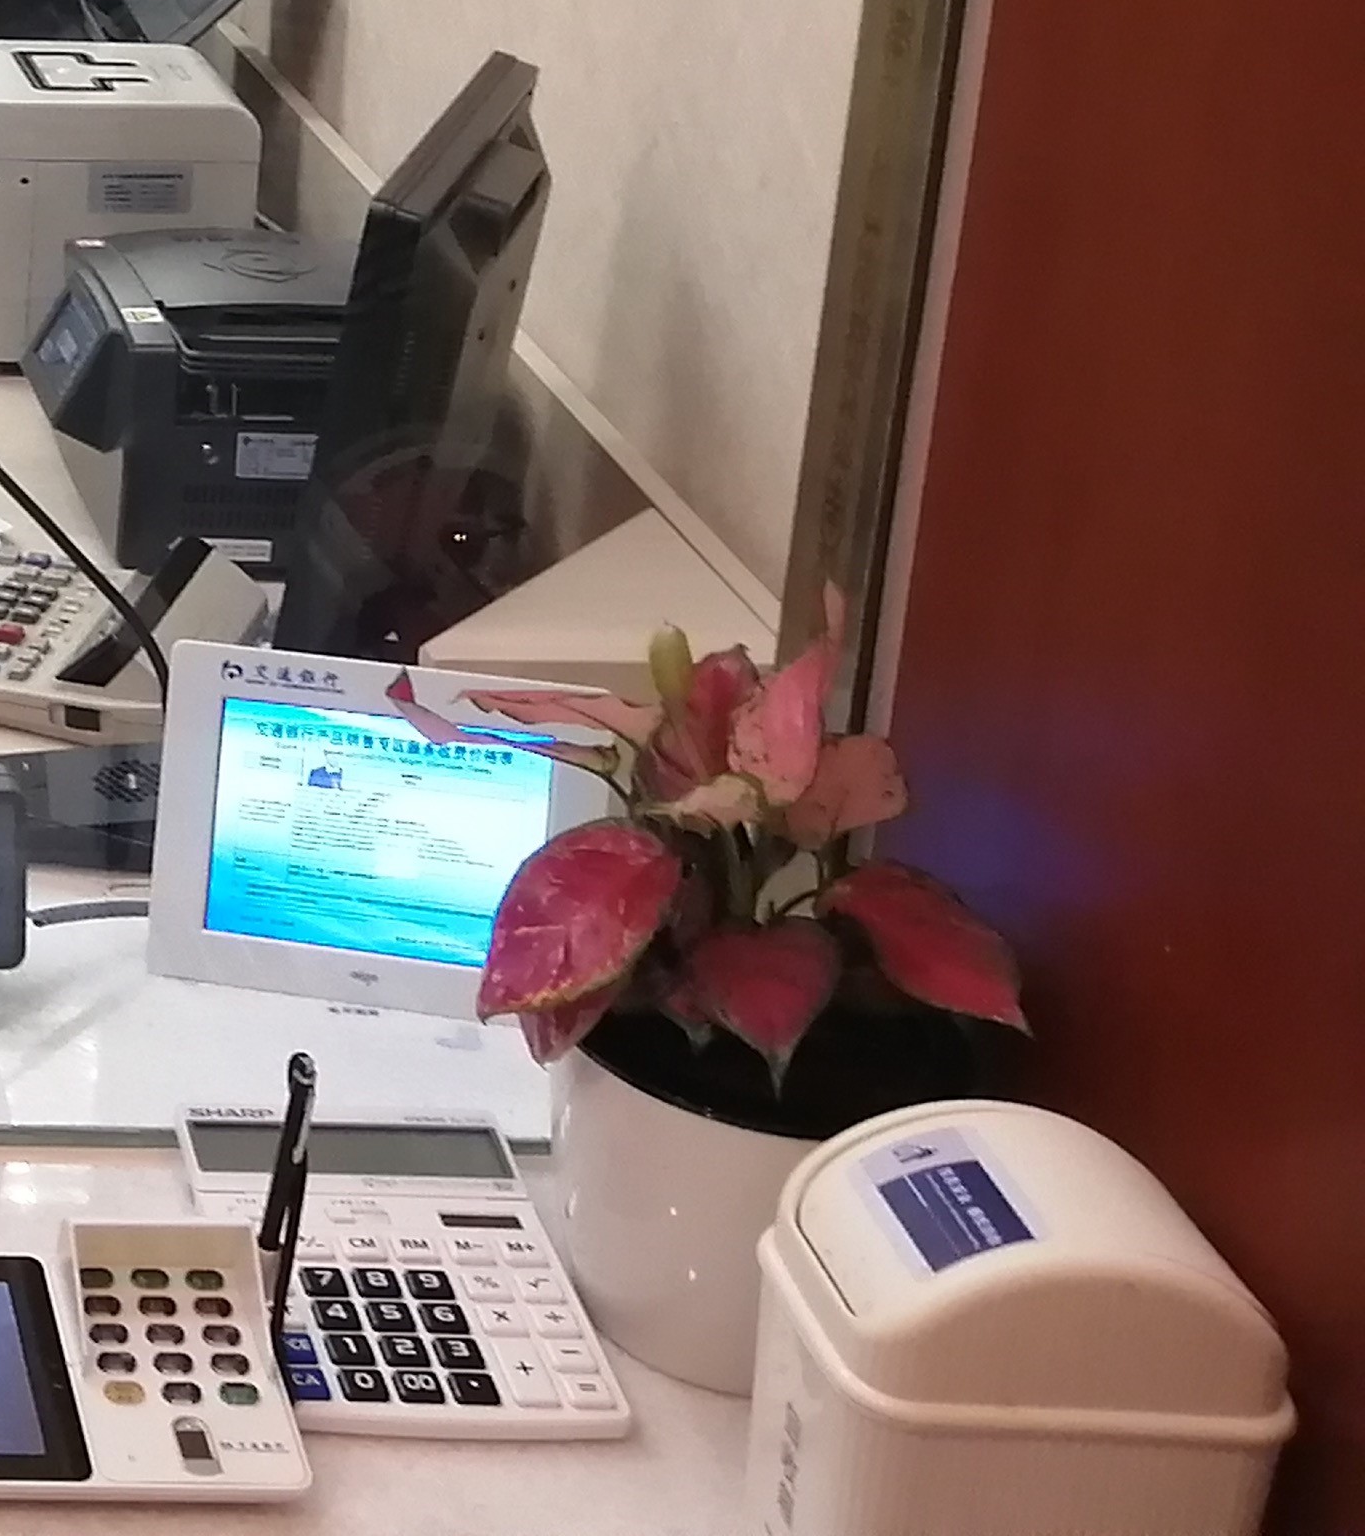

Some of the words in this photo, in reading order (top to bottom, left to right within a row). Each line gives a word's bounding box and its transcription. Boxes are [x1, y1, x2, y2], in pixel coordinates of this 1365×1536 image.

[187, 1107, 274, 1118] SHARP
[349, 1238, 376, 1249] CM
[399, 1239, 429, 1250] RM
[313, 1271, 333, 1286] 7
[366, 1272, 388, 1287] 8
[419, 1273, 442, 1288] 9
[326, 1304, 348, 1320] 4
[379, 1305, 402, 1320] 5
[432, 1306, 456, 1322] 6
[342, 1337, 358, 1353] 1
[395, 1339, 420, 1354] 2
[447, 1341, 471, 1357] 3
[292, 1373, 321, 1386] CA
[354, 1375, 375, 1390] 0
[401, 1375, 436, 1391] 00
